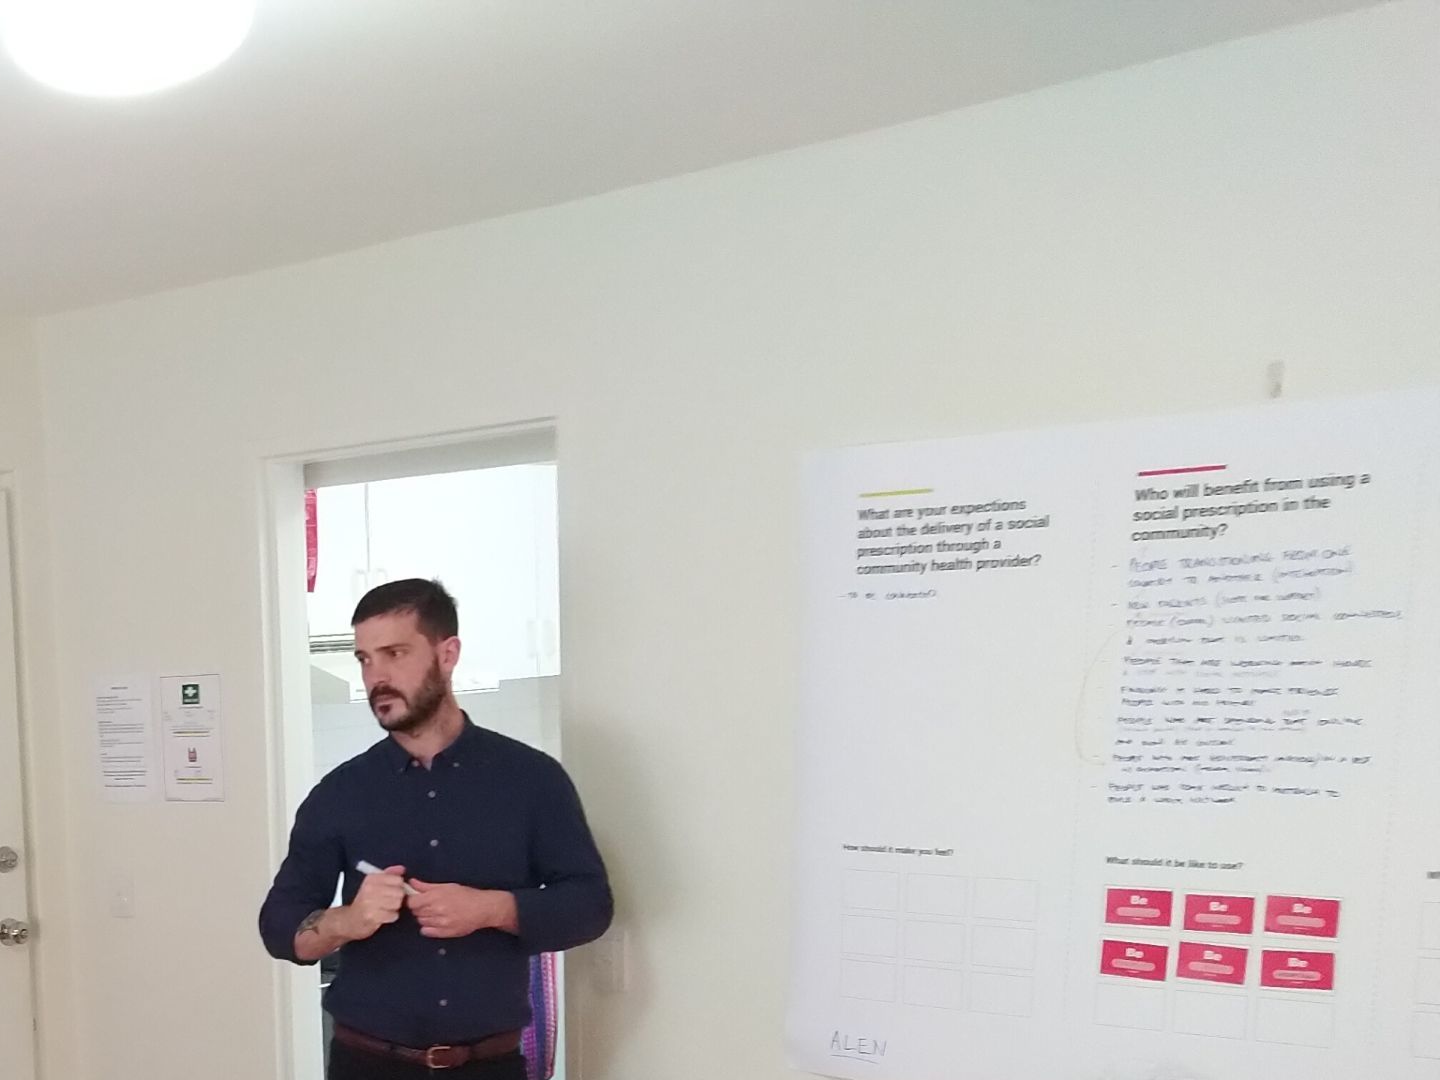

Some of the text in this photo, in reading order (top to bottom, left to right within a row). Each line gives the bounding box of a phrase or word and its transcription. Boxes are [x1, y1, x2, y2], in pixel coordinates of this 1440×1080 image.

[1134, 473, 1371, 501] Who will benefit from using a
[857, 499, 1027, 520] What are your expections
[1132, 494, 1332, 522] social prescription in the
[857, 515, 1051, 539] about the delivery of a social
[1131, 523, 1229, 542] community?
[857, 537, 1002, 559] prescription through a
[856, 554, 1042, 575] community health provider?
[1106, 856, 1129, 865] What
[1131, 857, 1163, 867] should
[1187, 859, 1206, 869] like
[830, 1030, 887, 1056] ALEN
